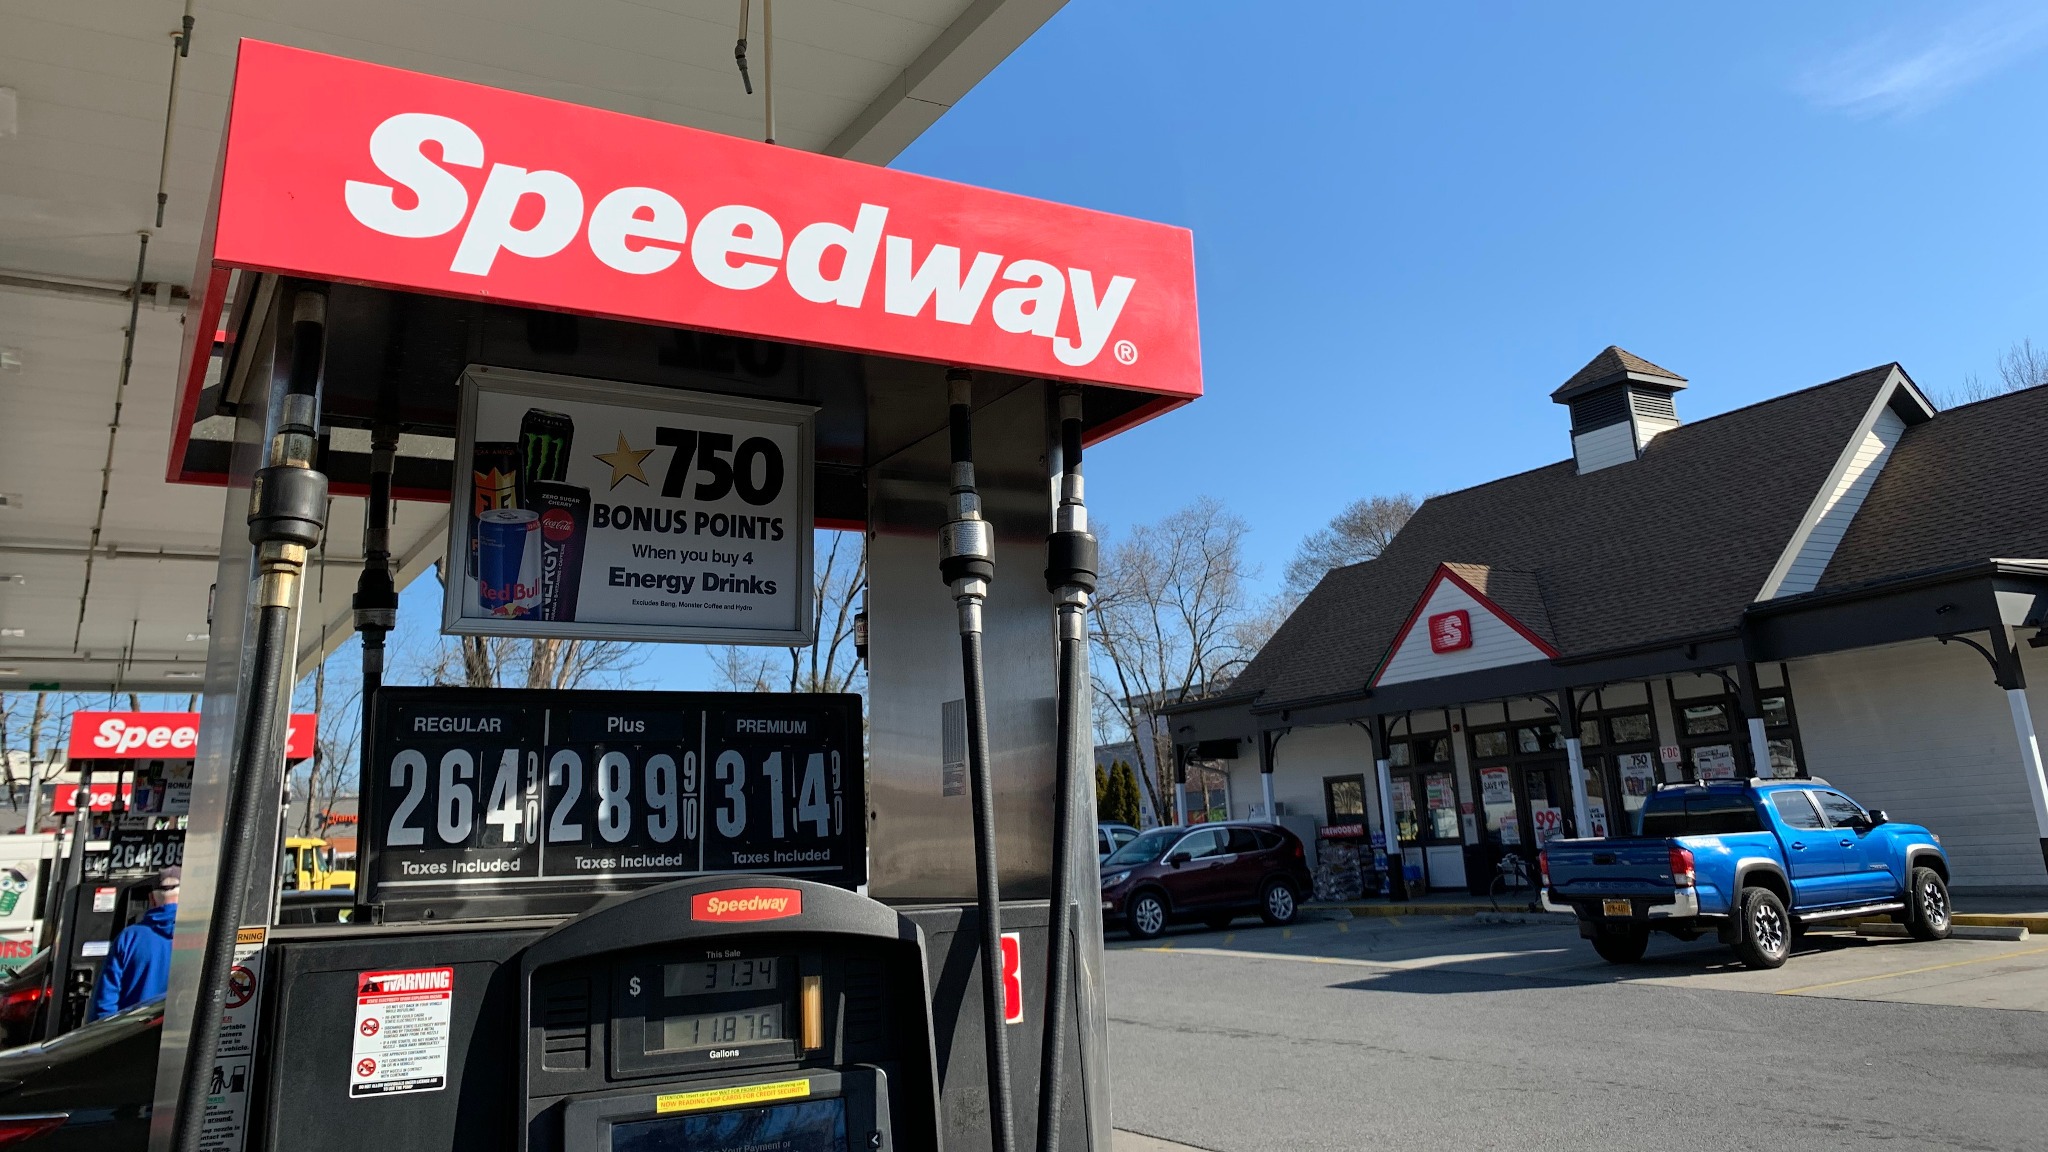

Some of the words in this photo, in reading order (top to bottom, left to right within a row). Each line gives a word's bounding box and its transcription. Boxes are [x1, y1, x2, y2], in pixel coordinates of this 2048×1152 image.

[344, 112, 1136, 367] Speedway
[655, 426, 784, 506] 750
[548, 500, 572, 508] CHERRY
[560, 496, 581, 504] SUGAR
[593, 503, 686, 534] BONUS
[694, 511, 784, 541] POINTS
[632, 543, 676, 560] When
[679, 550, 707, 564] you
[712, 549, 739, 566] buy
[742, 552, 753, 565] 4
[480, 580, 510, 600] Red
[514, 577, 540, 600] Bull
[608, 566, 695, 594] Energy
[702, 572, 777, 595] Drinks
[678, 601, 702, 609] Monster
[413, 717, 501, 732] REGULAR
[607, 717, 645, 733] Plus
[736, 719, 807, 734] PREMIUM
[1631, 754, 1648, 765] 750
[1661, 747, 1678, 759] FDC
[386, 748, 522, 847] 264
[548, 746, 678, 844] 289
[715, 750, 830, 839] 314
[110, 843, 147, 868] 264
[574, 856, 616, 870] Taxes
[620, 854, 682, 869] Included
[732, 850, 770, 865] Taxes
[774, 849, 830, 863] Included
[401, 860, 447, 875] Taxes
[451, 858, 520, 873] Included
[707, 895, 789, 915] Speedway
[706, 950, 722, 959] This
[725, 948, 741, 958] Sale
[383, 971, 450, 992] WARNING
[705, 961, 771, 989] 31.34
[629, 975, 641, 997] $
[694, 1014, 771, 1044] 11.876
[709, 1048, 739, 1059] Gallons
[756, 1090, 776, 1098] CREDIT
[777, 1087, 804, 1095] SECURITY
[744, 1141, 780, 1152] Payment
[782, 1140, 791, 1148] or
